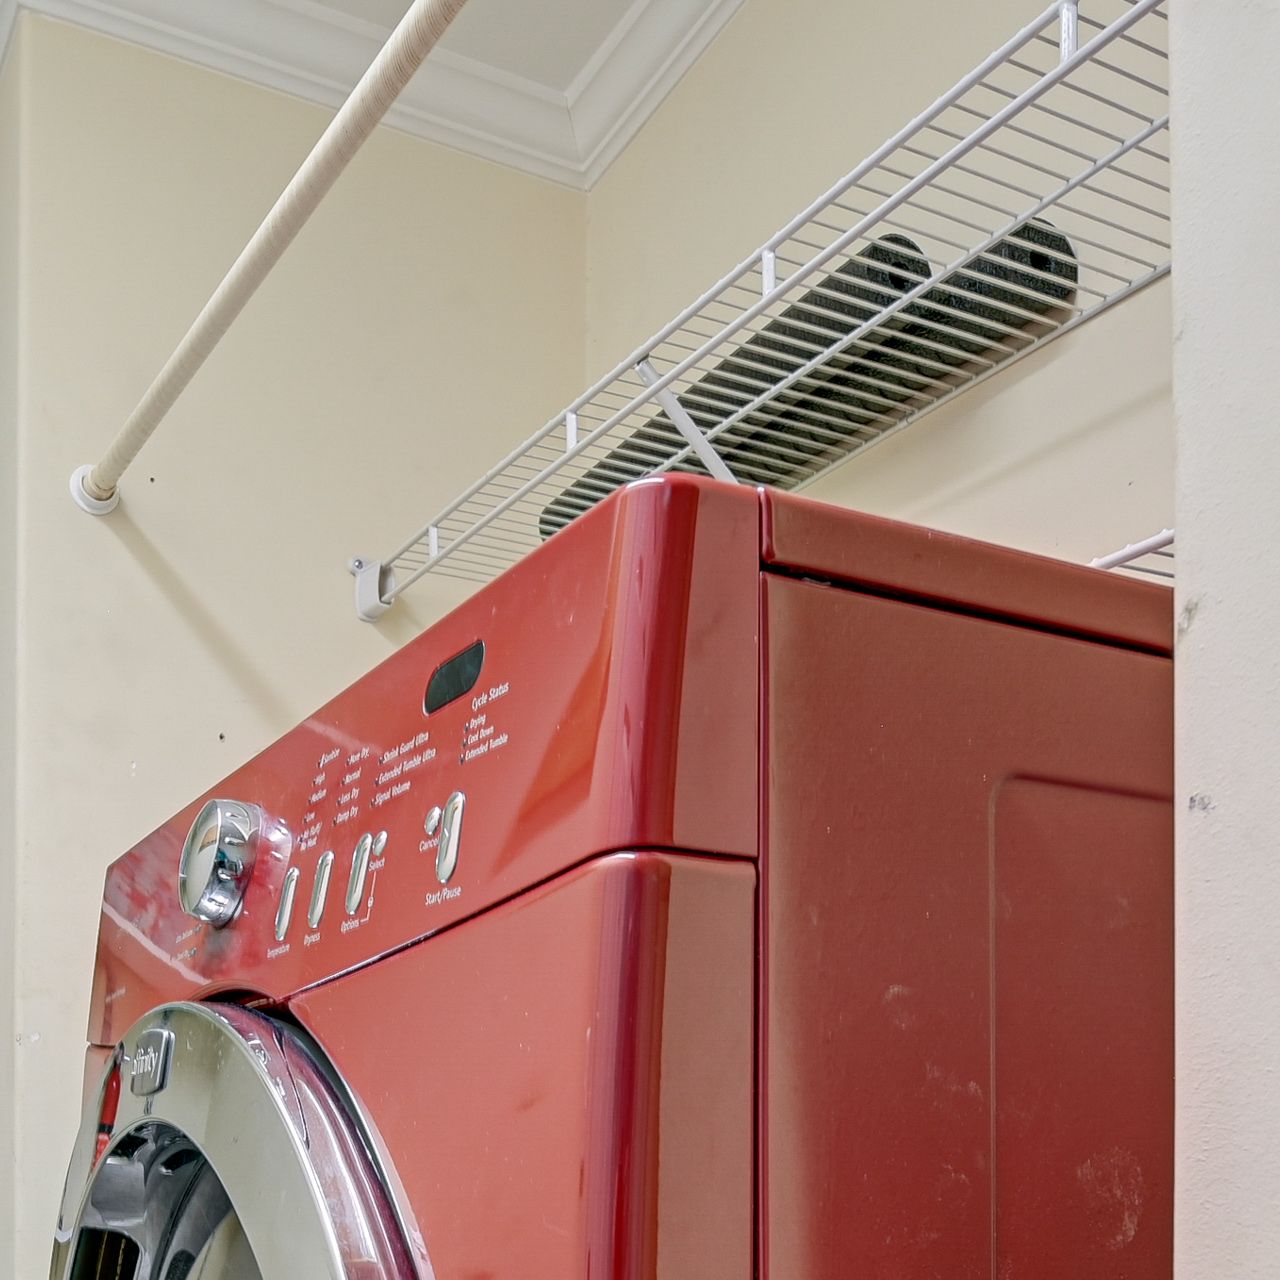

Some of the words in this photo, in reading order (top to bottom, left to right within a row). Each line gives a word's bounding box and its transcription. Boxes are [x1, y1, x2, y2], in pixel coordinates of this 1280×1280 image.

[472, 692, 487, 711] Cycle
[489, 682, 509, 701] Status
[470, 714, 486, 730] Drying
[468, 730, 479, 745] Cool
[480, 726, 494, 739] Down
[400, 736, 415, 755] Guard
[465, 741, 489, 760] Extended
[490, 733, 508, 749] Tumble
[379, 763, 402, 784] Extended
[403, 754, 422, 772] Tumble
[375, 787, 391, 806] Signal
[369, 857, 385, 872] Select
[425, 887, 462, 906] Start/Pause
[341, 919, 360, 934] Options
